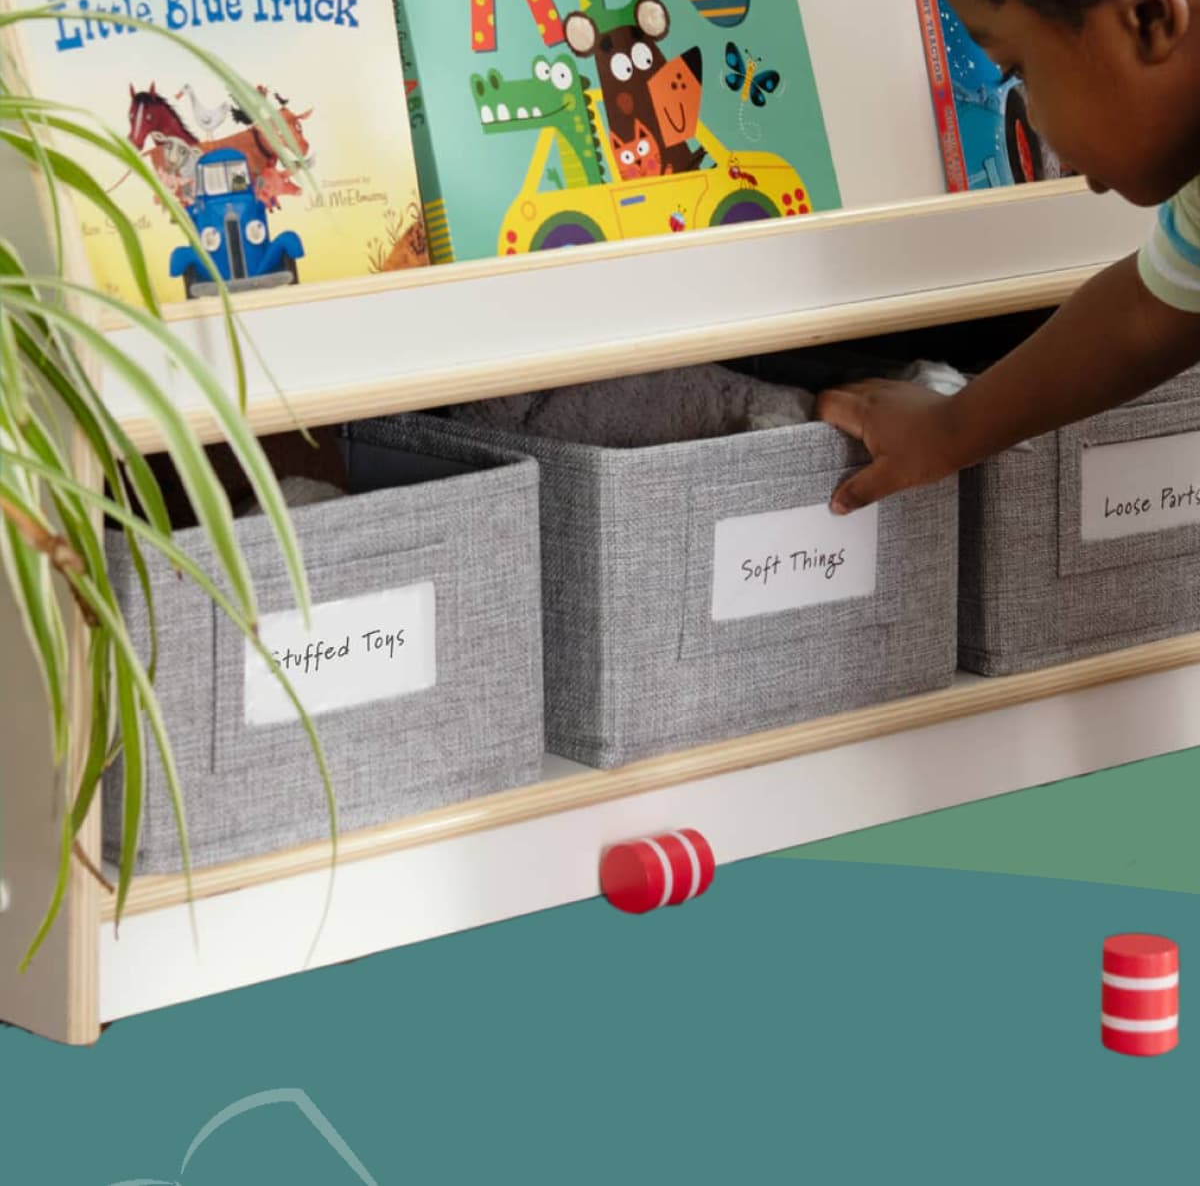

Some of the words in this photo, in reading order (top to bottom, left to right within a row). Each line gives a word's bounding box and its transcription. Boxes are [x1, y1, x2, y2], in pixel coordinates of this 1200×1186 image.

[926, 19, 942, 82] TRACTOR
[1104, 496, 1151, 518] Loose
[741, 554, 781, 584] Soft
[790, 548, 845, 579] Things
[362, 629, 406, 658] Toys
